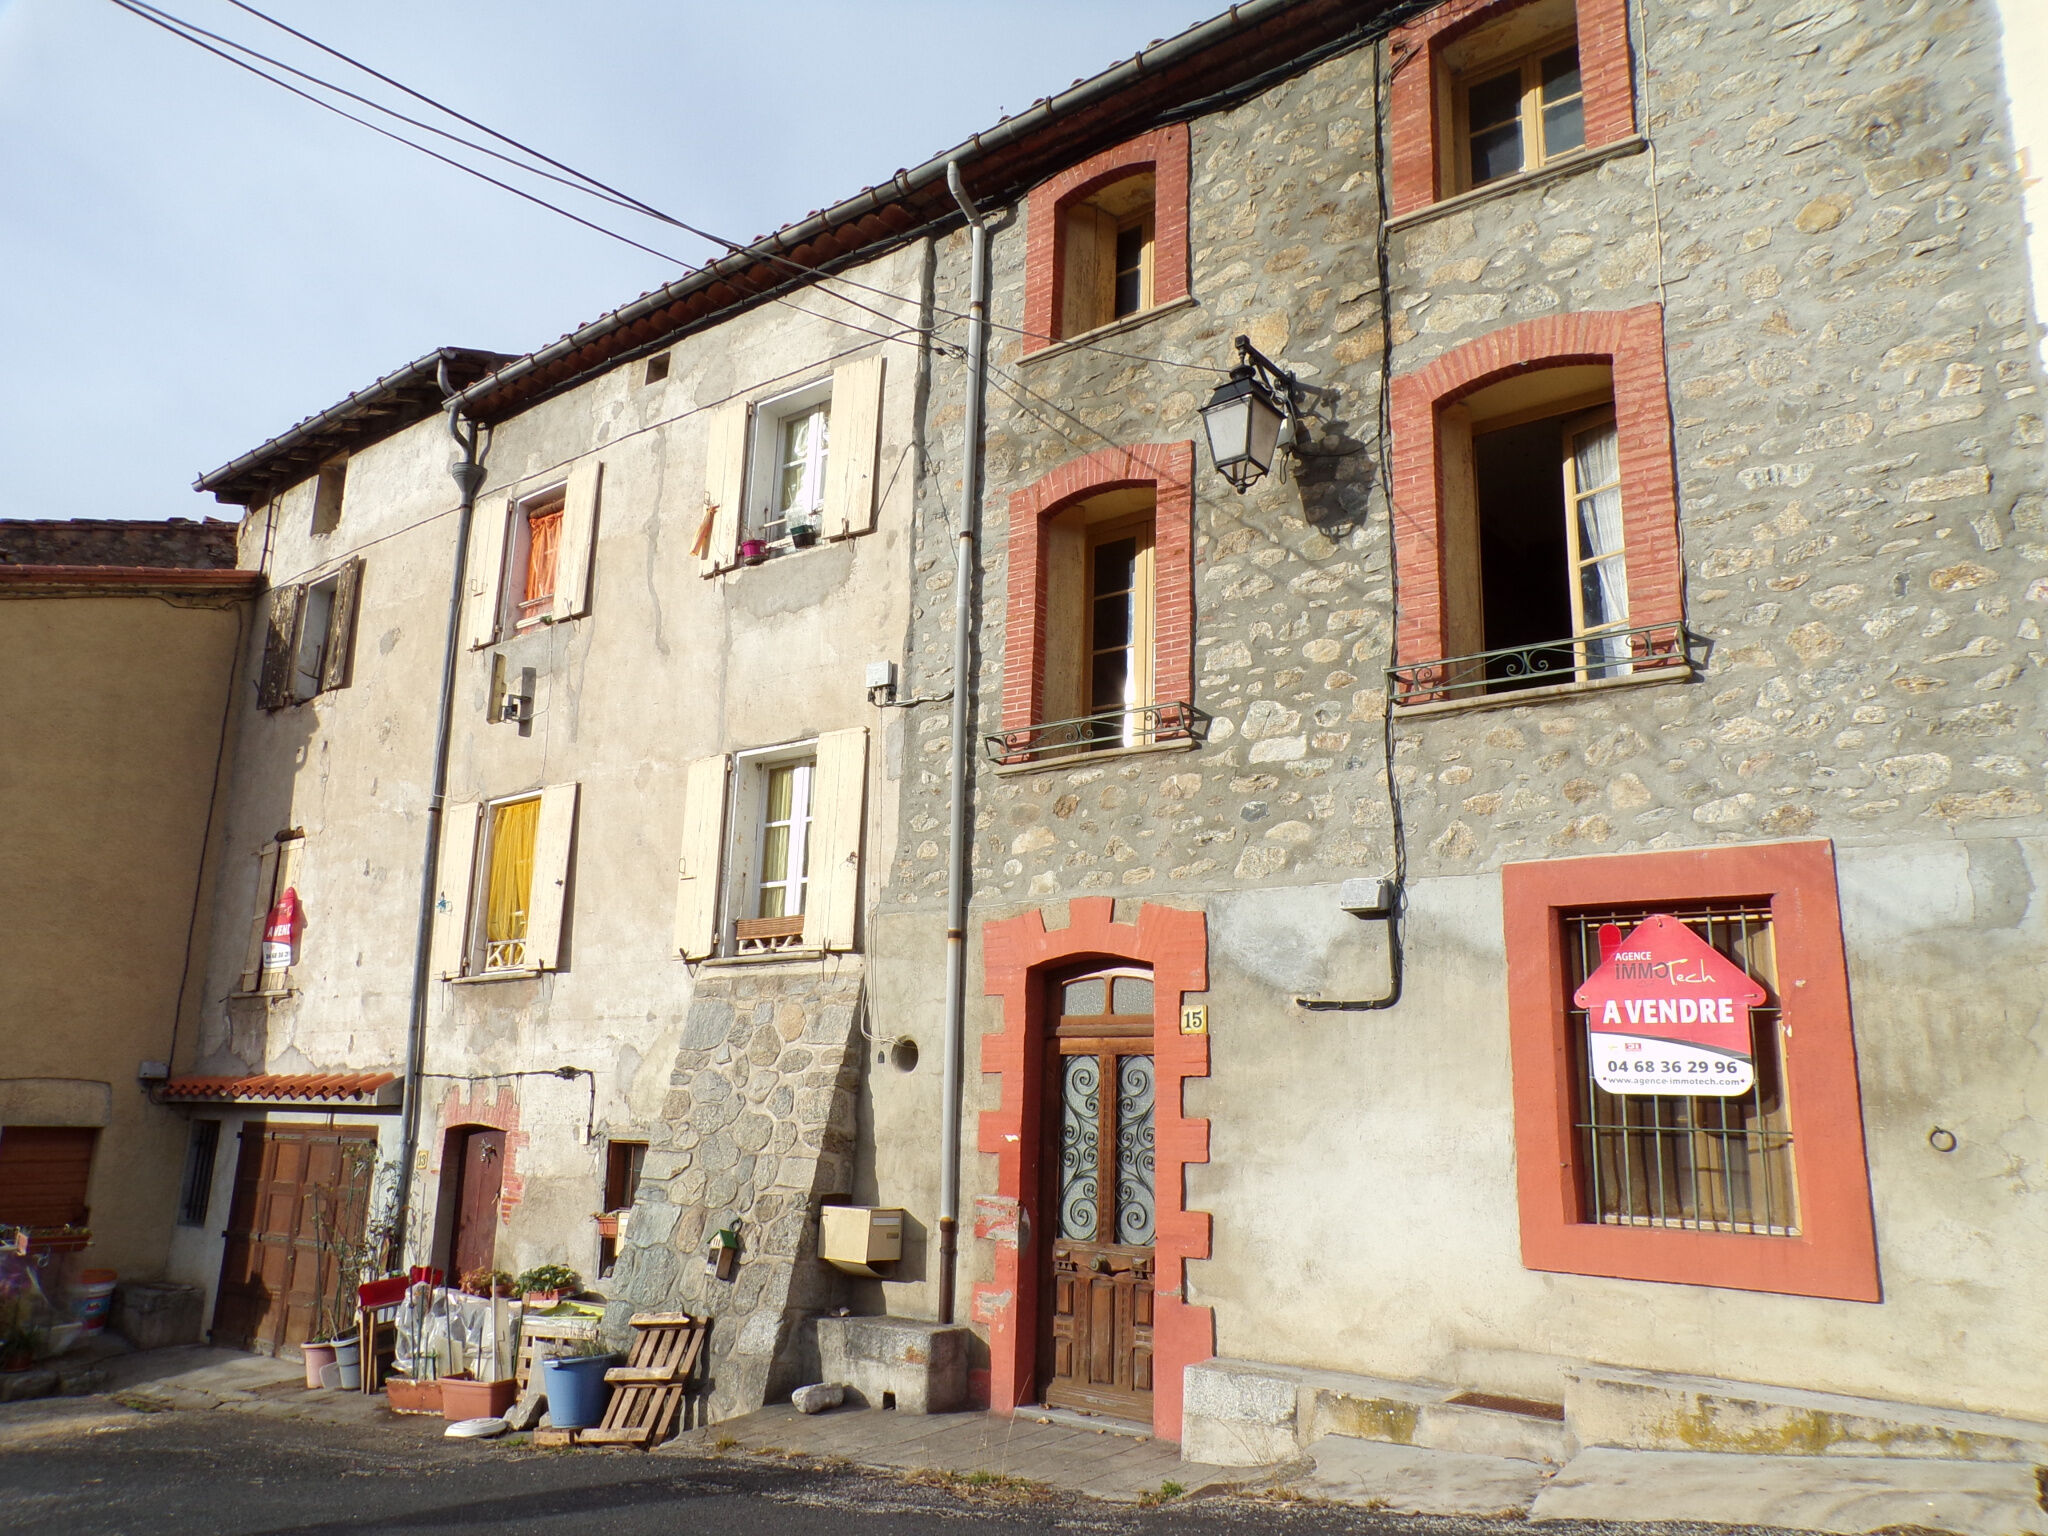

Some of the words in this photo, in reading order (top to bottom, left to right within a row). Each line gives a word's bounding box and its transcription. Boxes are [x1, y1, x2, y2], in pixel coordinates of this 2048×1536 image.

[1615, 952, 1652, 961] AGENCE
[1602, 1000, 1622, 1024] A
[1624, 998, 1735, 1024] VENDRE
[1184, 1010, 1203, 1029] 15
[1607, 1060, 1629, 1073] 04
[1634, 1060, 1655, 1073] 68
[1660, 1061, 1682, 1073] 36
[1687, 1061, 1709, 1073] 29
[1714, 1061, 1738, 1074] 96
[1608, 1077, 1740, 1086] www.agence-immotech.com
[418, 1154, 427, 1167] 13
